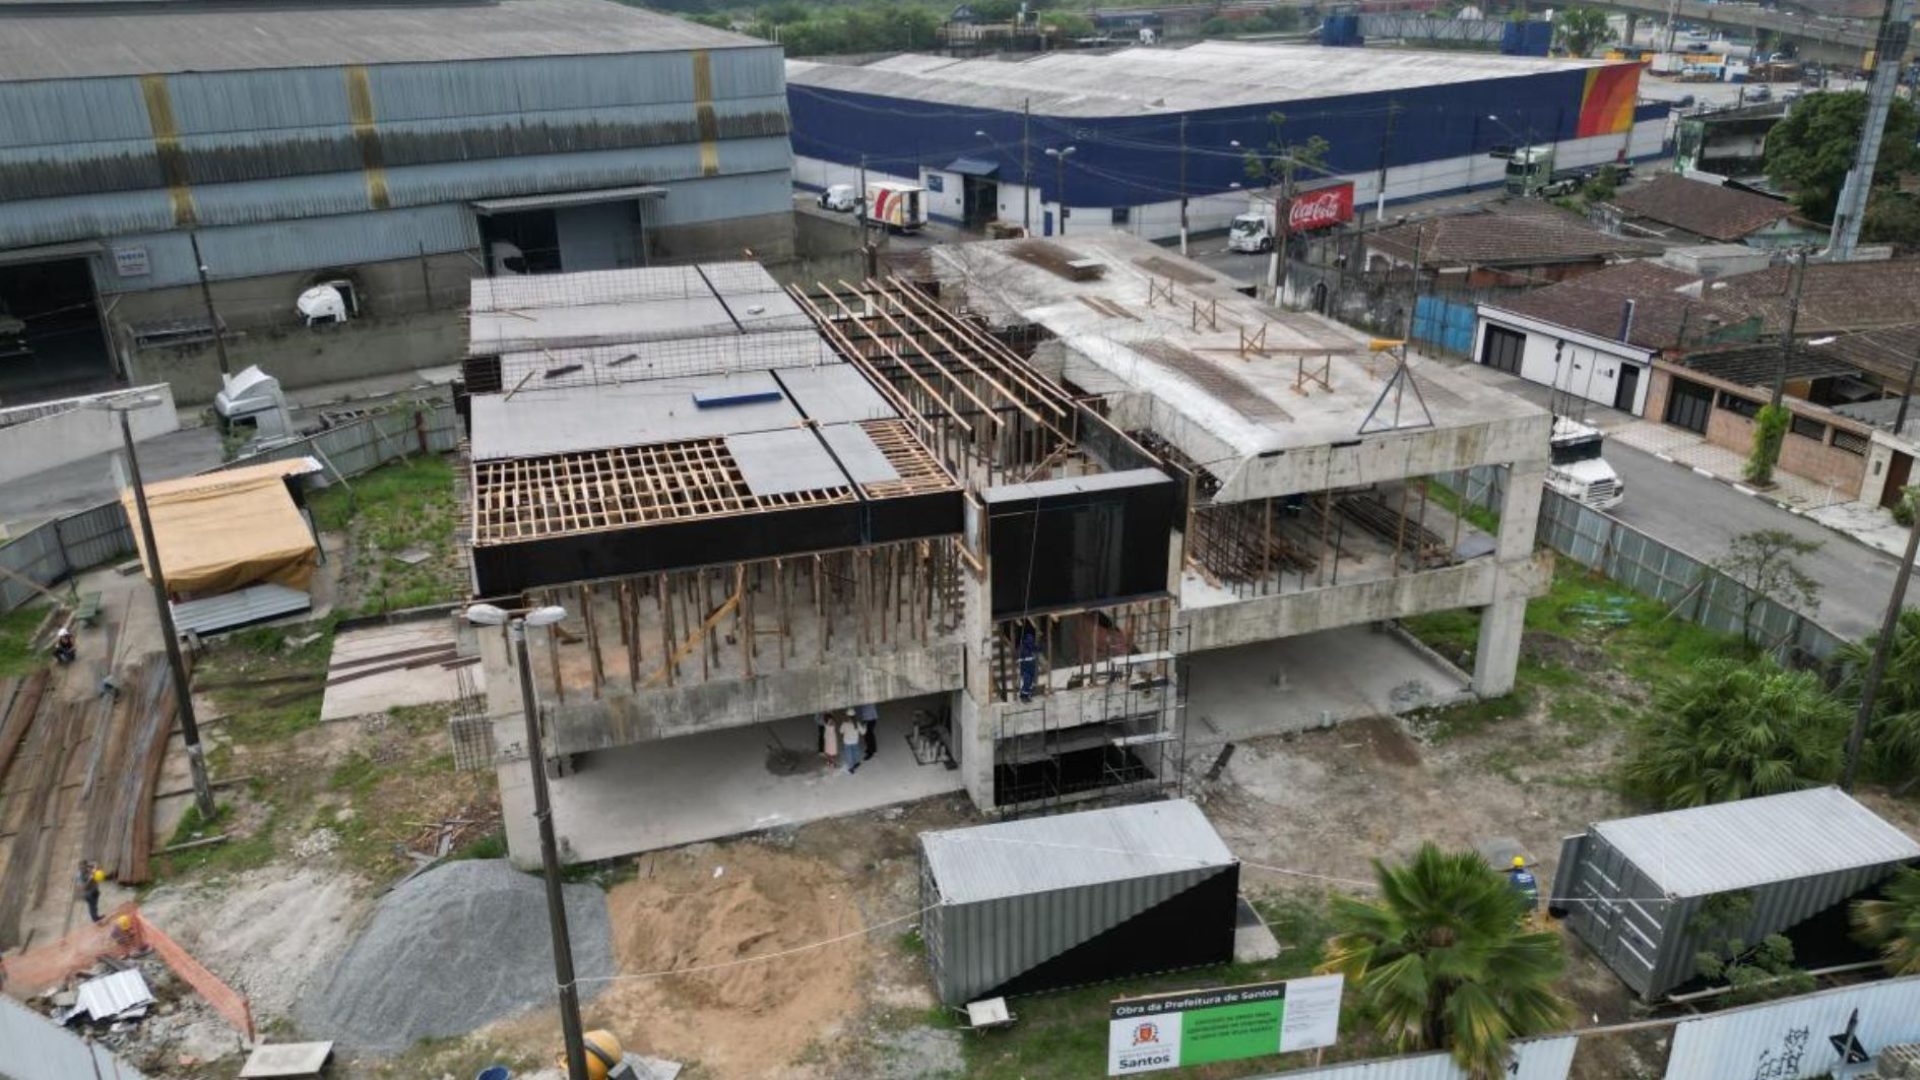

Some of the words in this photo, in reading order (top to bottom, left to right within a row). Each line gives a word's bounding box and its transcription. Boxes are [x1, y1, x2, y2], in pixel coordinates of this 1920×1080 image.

[1116, 1005, 1144, 1016] Obra
[1147, 1003, 1163, 1012] da
[1164, 994, 1221, 1010] Prefeitura
[1224, 993, 1239, 1002] de
[1241, 988, 1279, 1000] Santos
[1119, 1054, 1170, 1070] Santos
